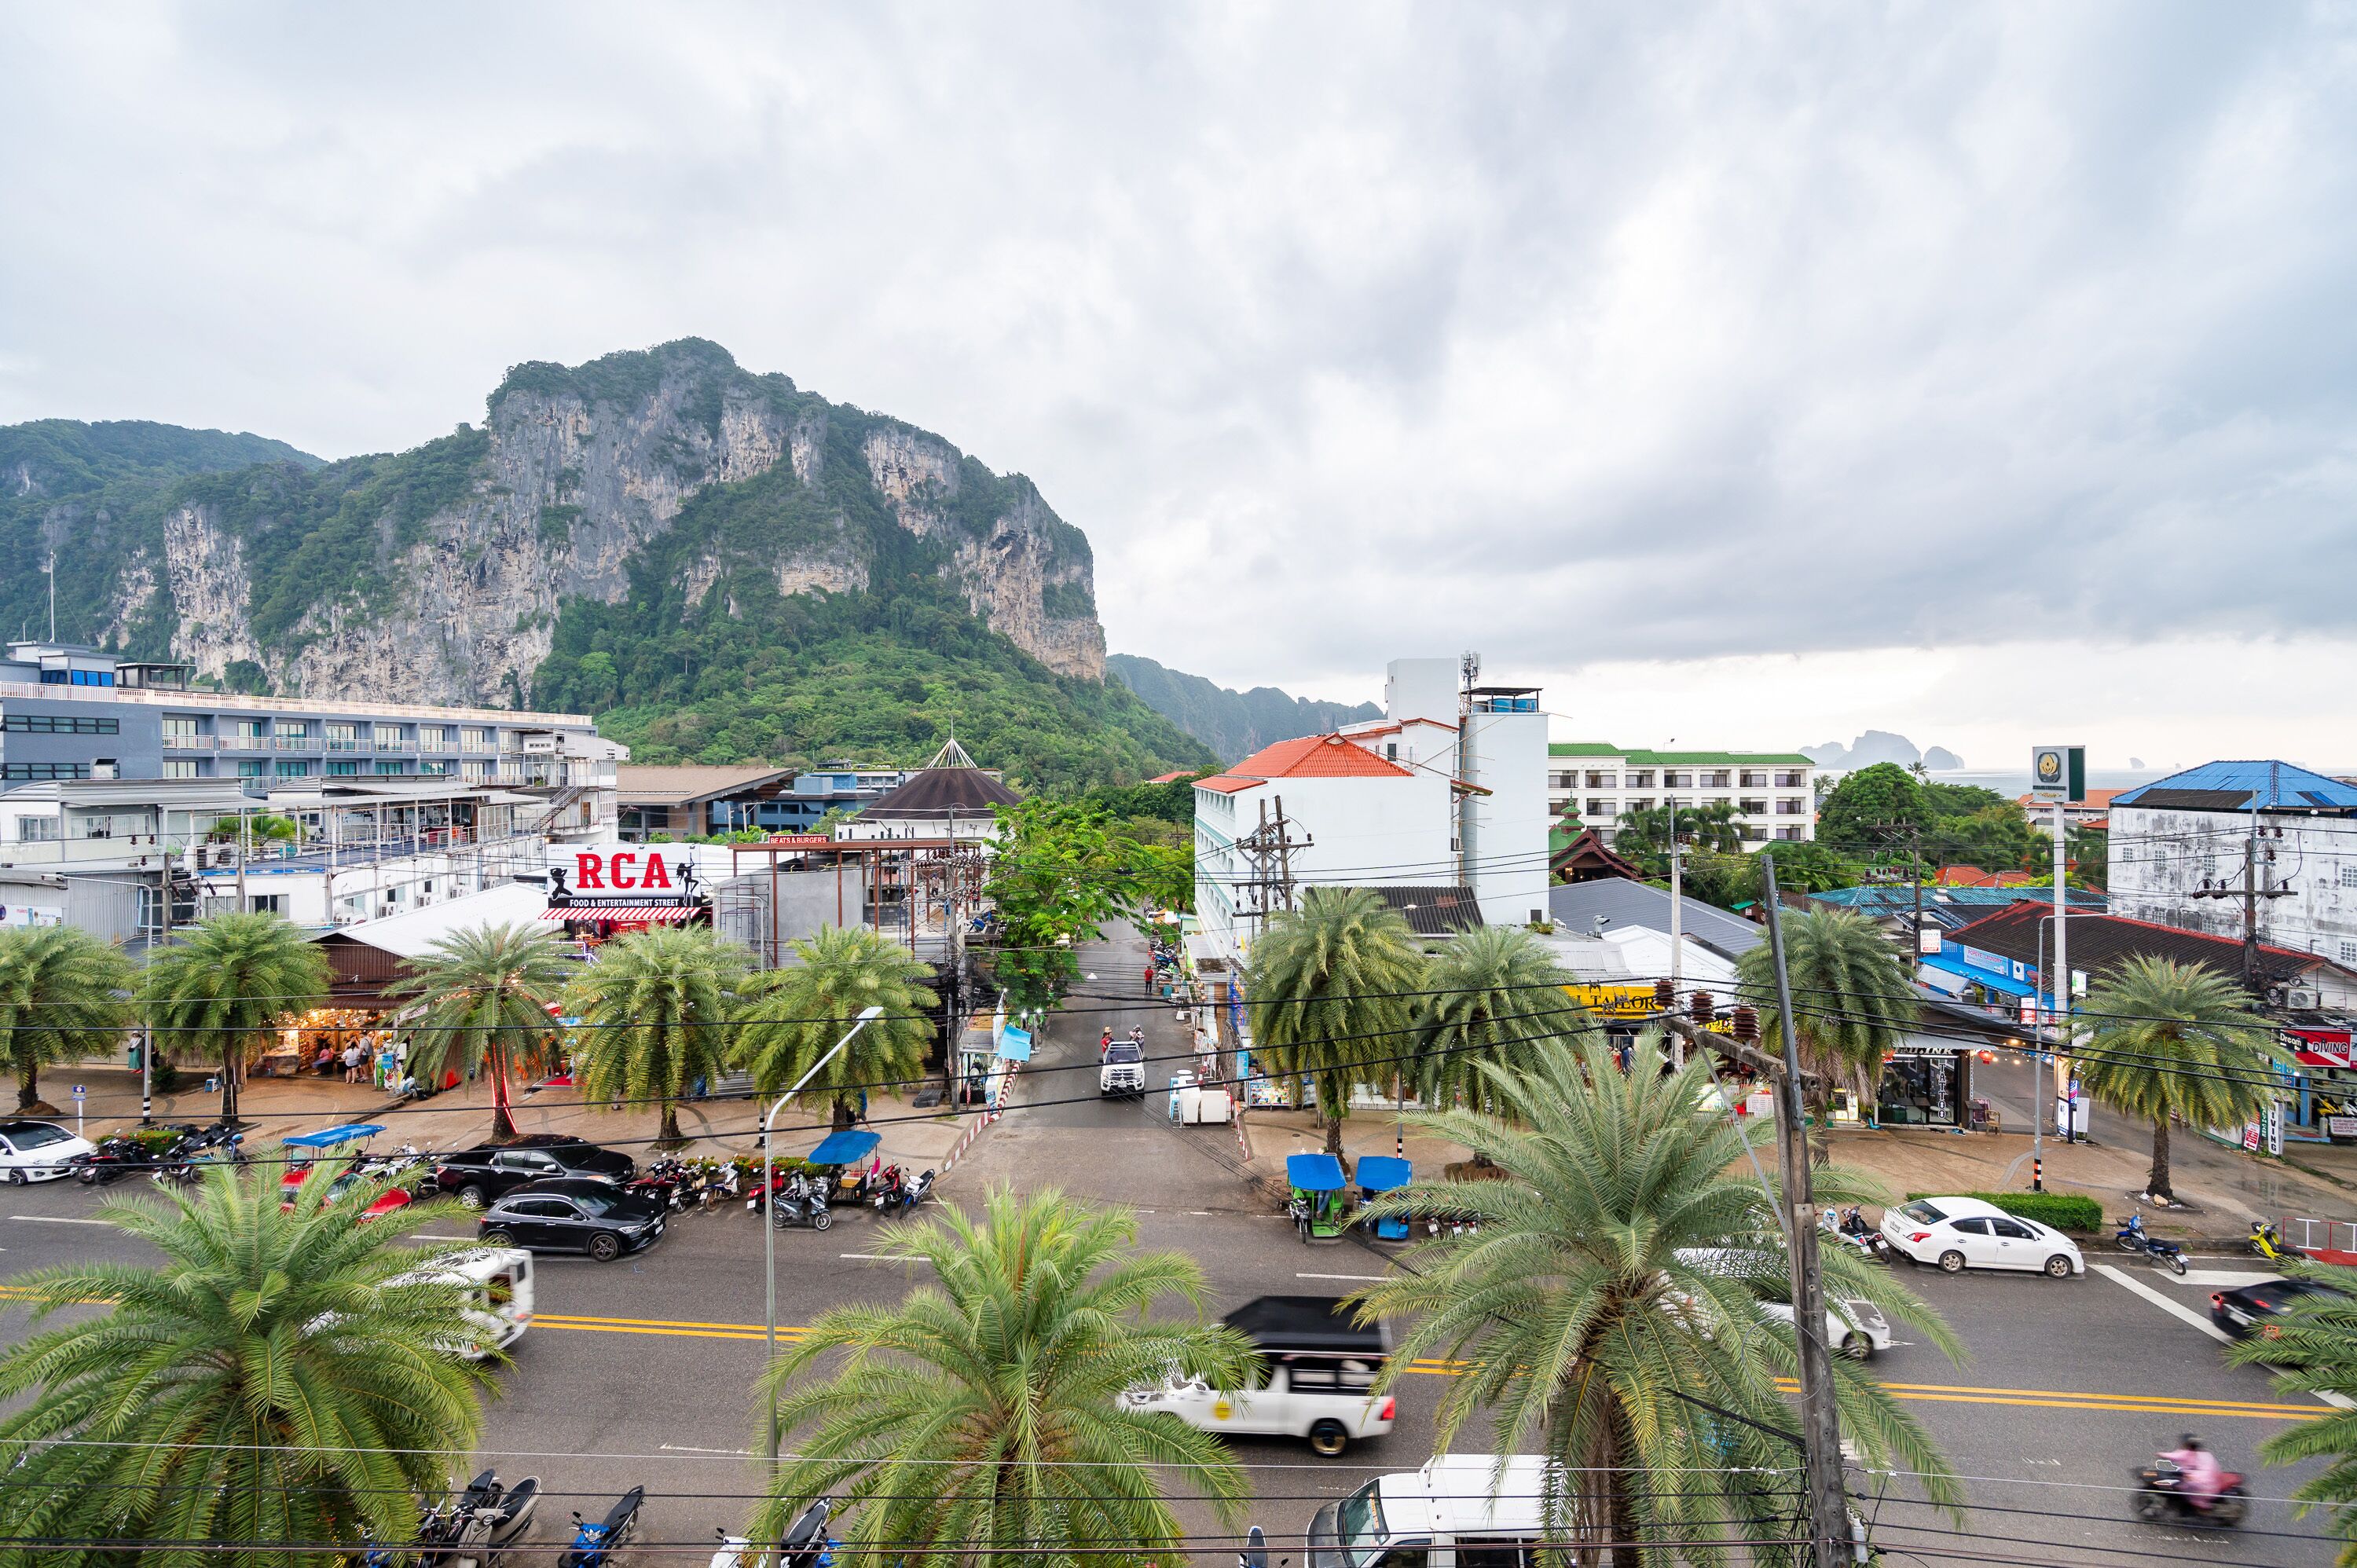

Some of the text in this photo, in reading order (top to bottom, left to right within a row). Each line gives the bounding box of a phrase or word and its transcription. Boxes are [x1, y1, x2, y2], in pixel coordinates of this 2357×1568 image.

[576, 853, 672, 888] RCA
[2280, 1032, 2302, 1046] Dream
[2312, 1041, 2348, 1053] DIVING
